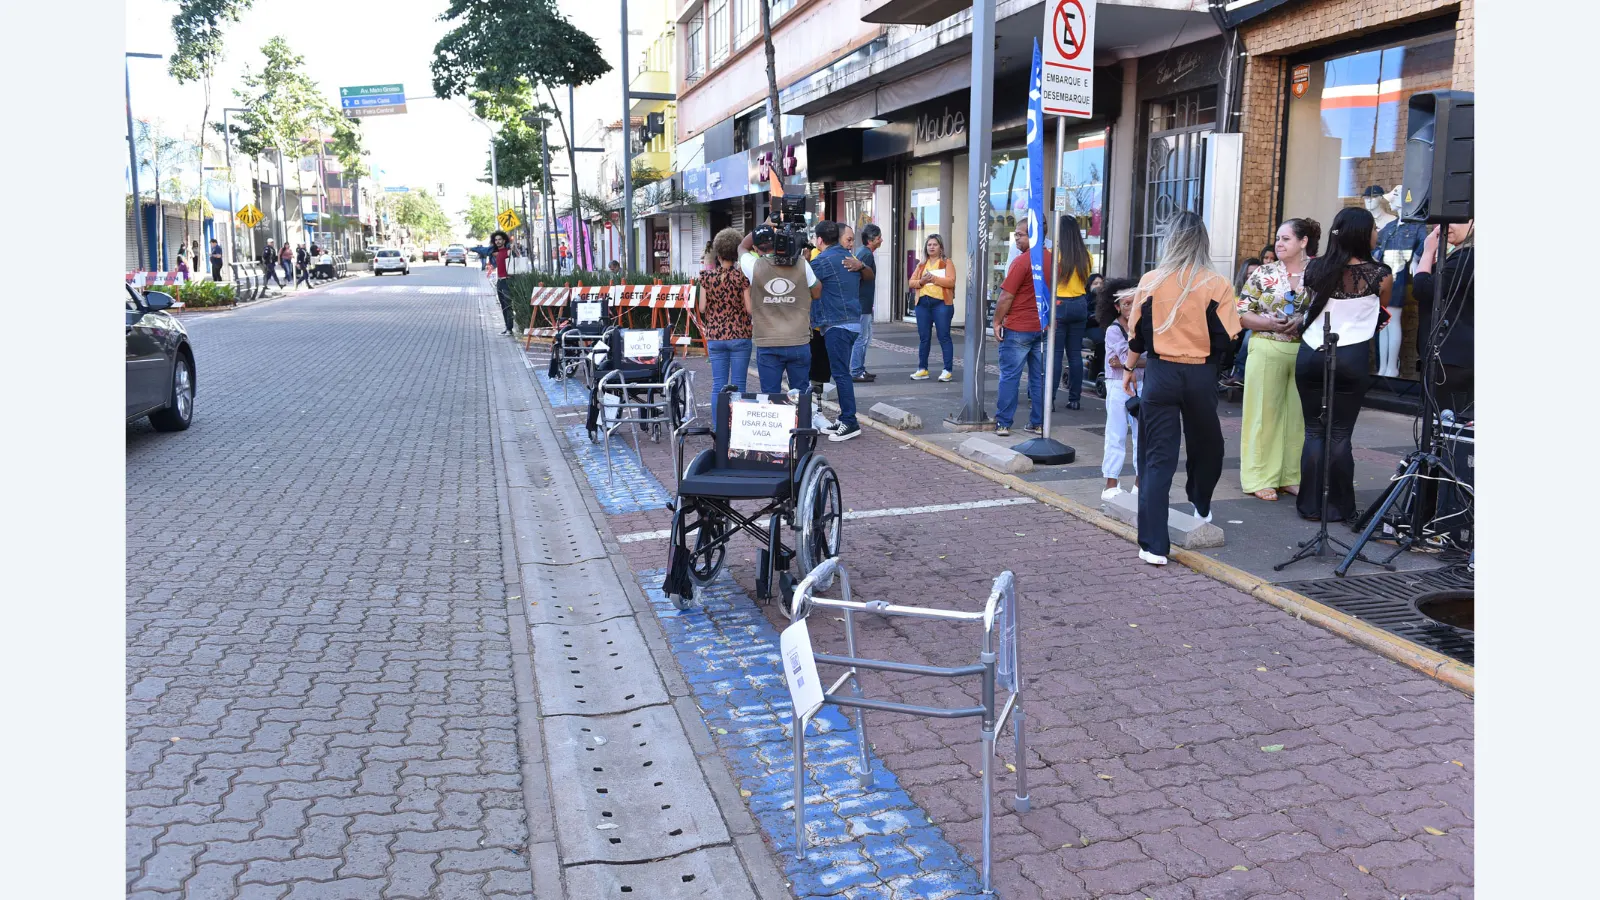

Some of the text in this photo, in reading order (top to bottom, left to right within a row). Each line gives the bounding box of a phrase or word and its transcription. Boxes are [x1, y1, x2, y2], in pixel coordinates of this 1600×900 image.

[1046, 73, 1088, 87] EMBARQUE E
[1043, 90, 1090, 105] DESEMBARQUE
